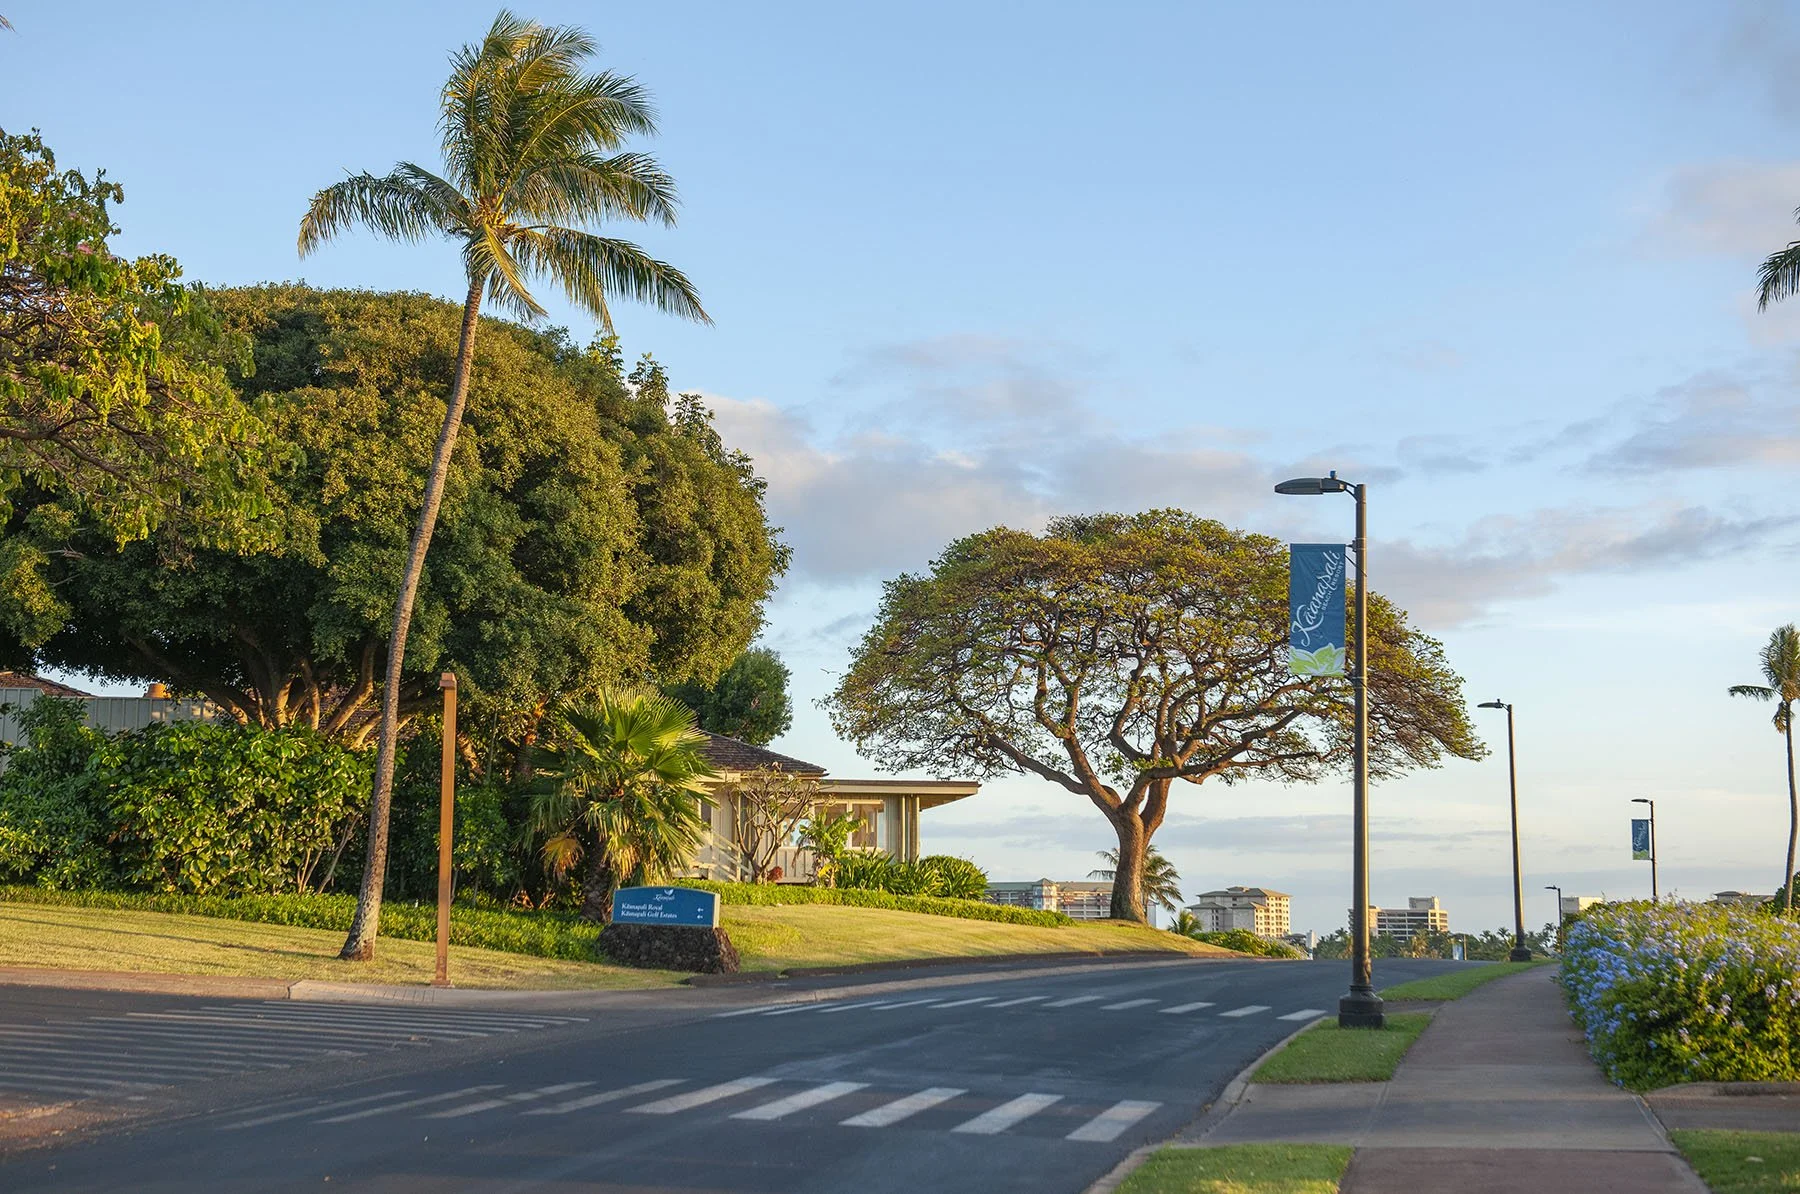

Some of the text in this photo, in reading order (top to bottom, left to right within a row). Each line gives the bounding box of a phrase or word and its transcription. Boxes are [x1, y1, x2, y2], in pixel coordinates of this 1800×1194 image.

[1321, 561, 1344, 611] BEACH RESORT
[648, 904, 663, 912] Royal
